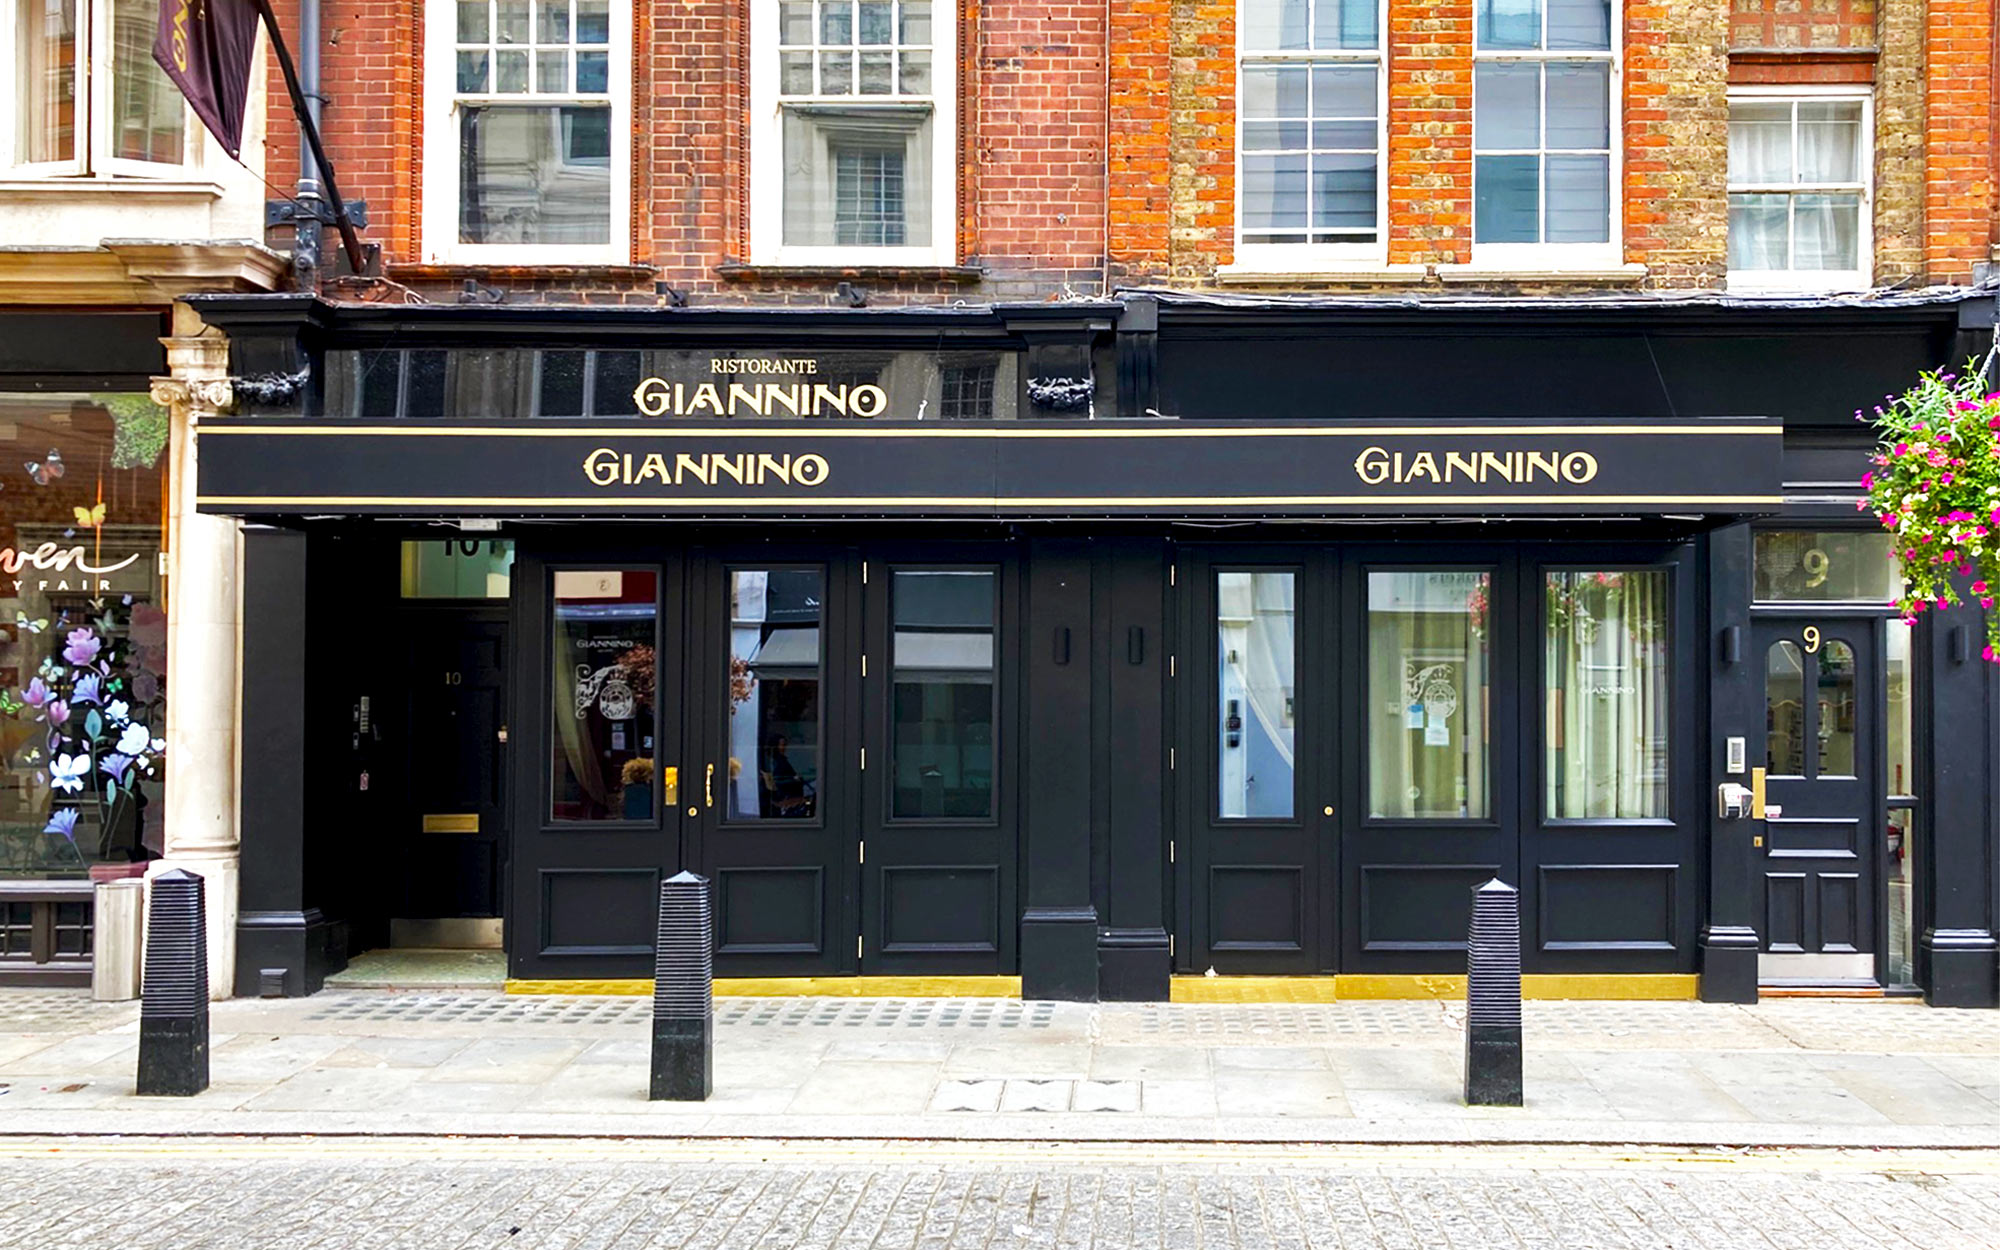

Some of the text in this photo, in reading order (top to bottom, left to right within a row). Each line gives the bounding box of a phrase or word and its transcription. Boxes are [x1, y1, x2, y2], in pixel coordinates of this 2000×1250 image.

[710, 358, 817, 375] RISTORANTE
[632, 376, 888, 418] GIANNINO
[582, 447, 831, 487] GIANNINO
[1353, 446, 1599, 485] GIANNINO
[1803, 548, 1829, 588] 9
[576, 639, 634, 649] GIANNINO
[1803, 625, 1820, 654] 9
[445, 671, 462, 685] 10
